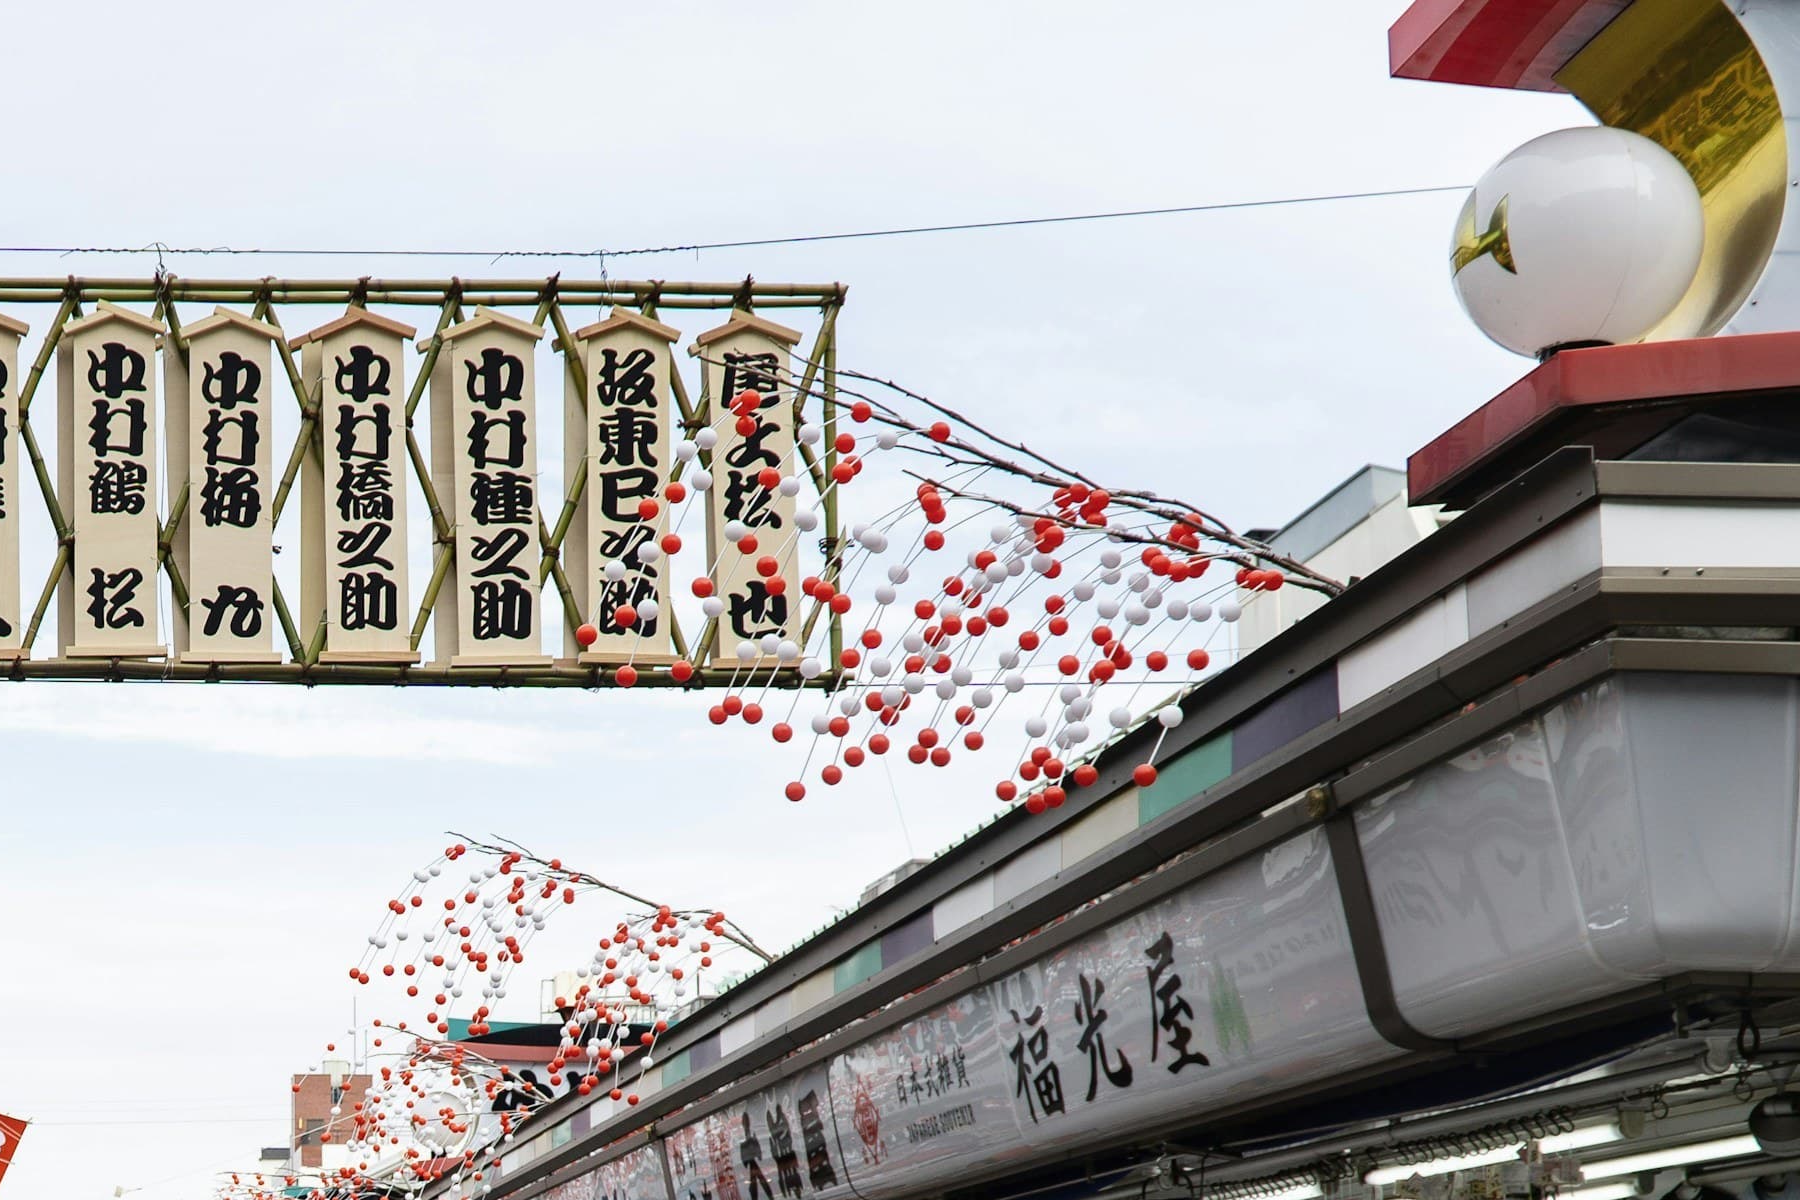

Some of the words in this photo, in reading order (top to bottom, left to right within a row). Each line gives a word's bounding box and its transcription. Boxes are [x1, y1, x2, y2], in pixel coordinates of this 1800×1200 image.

[87, 343, 147, 628] 中村鶴松
[335, 346, 397, 630] 中村橋之助
[465, 349, 532, 640] 中村種之助
[1011, 932, 1209, 1124] 福光屋
